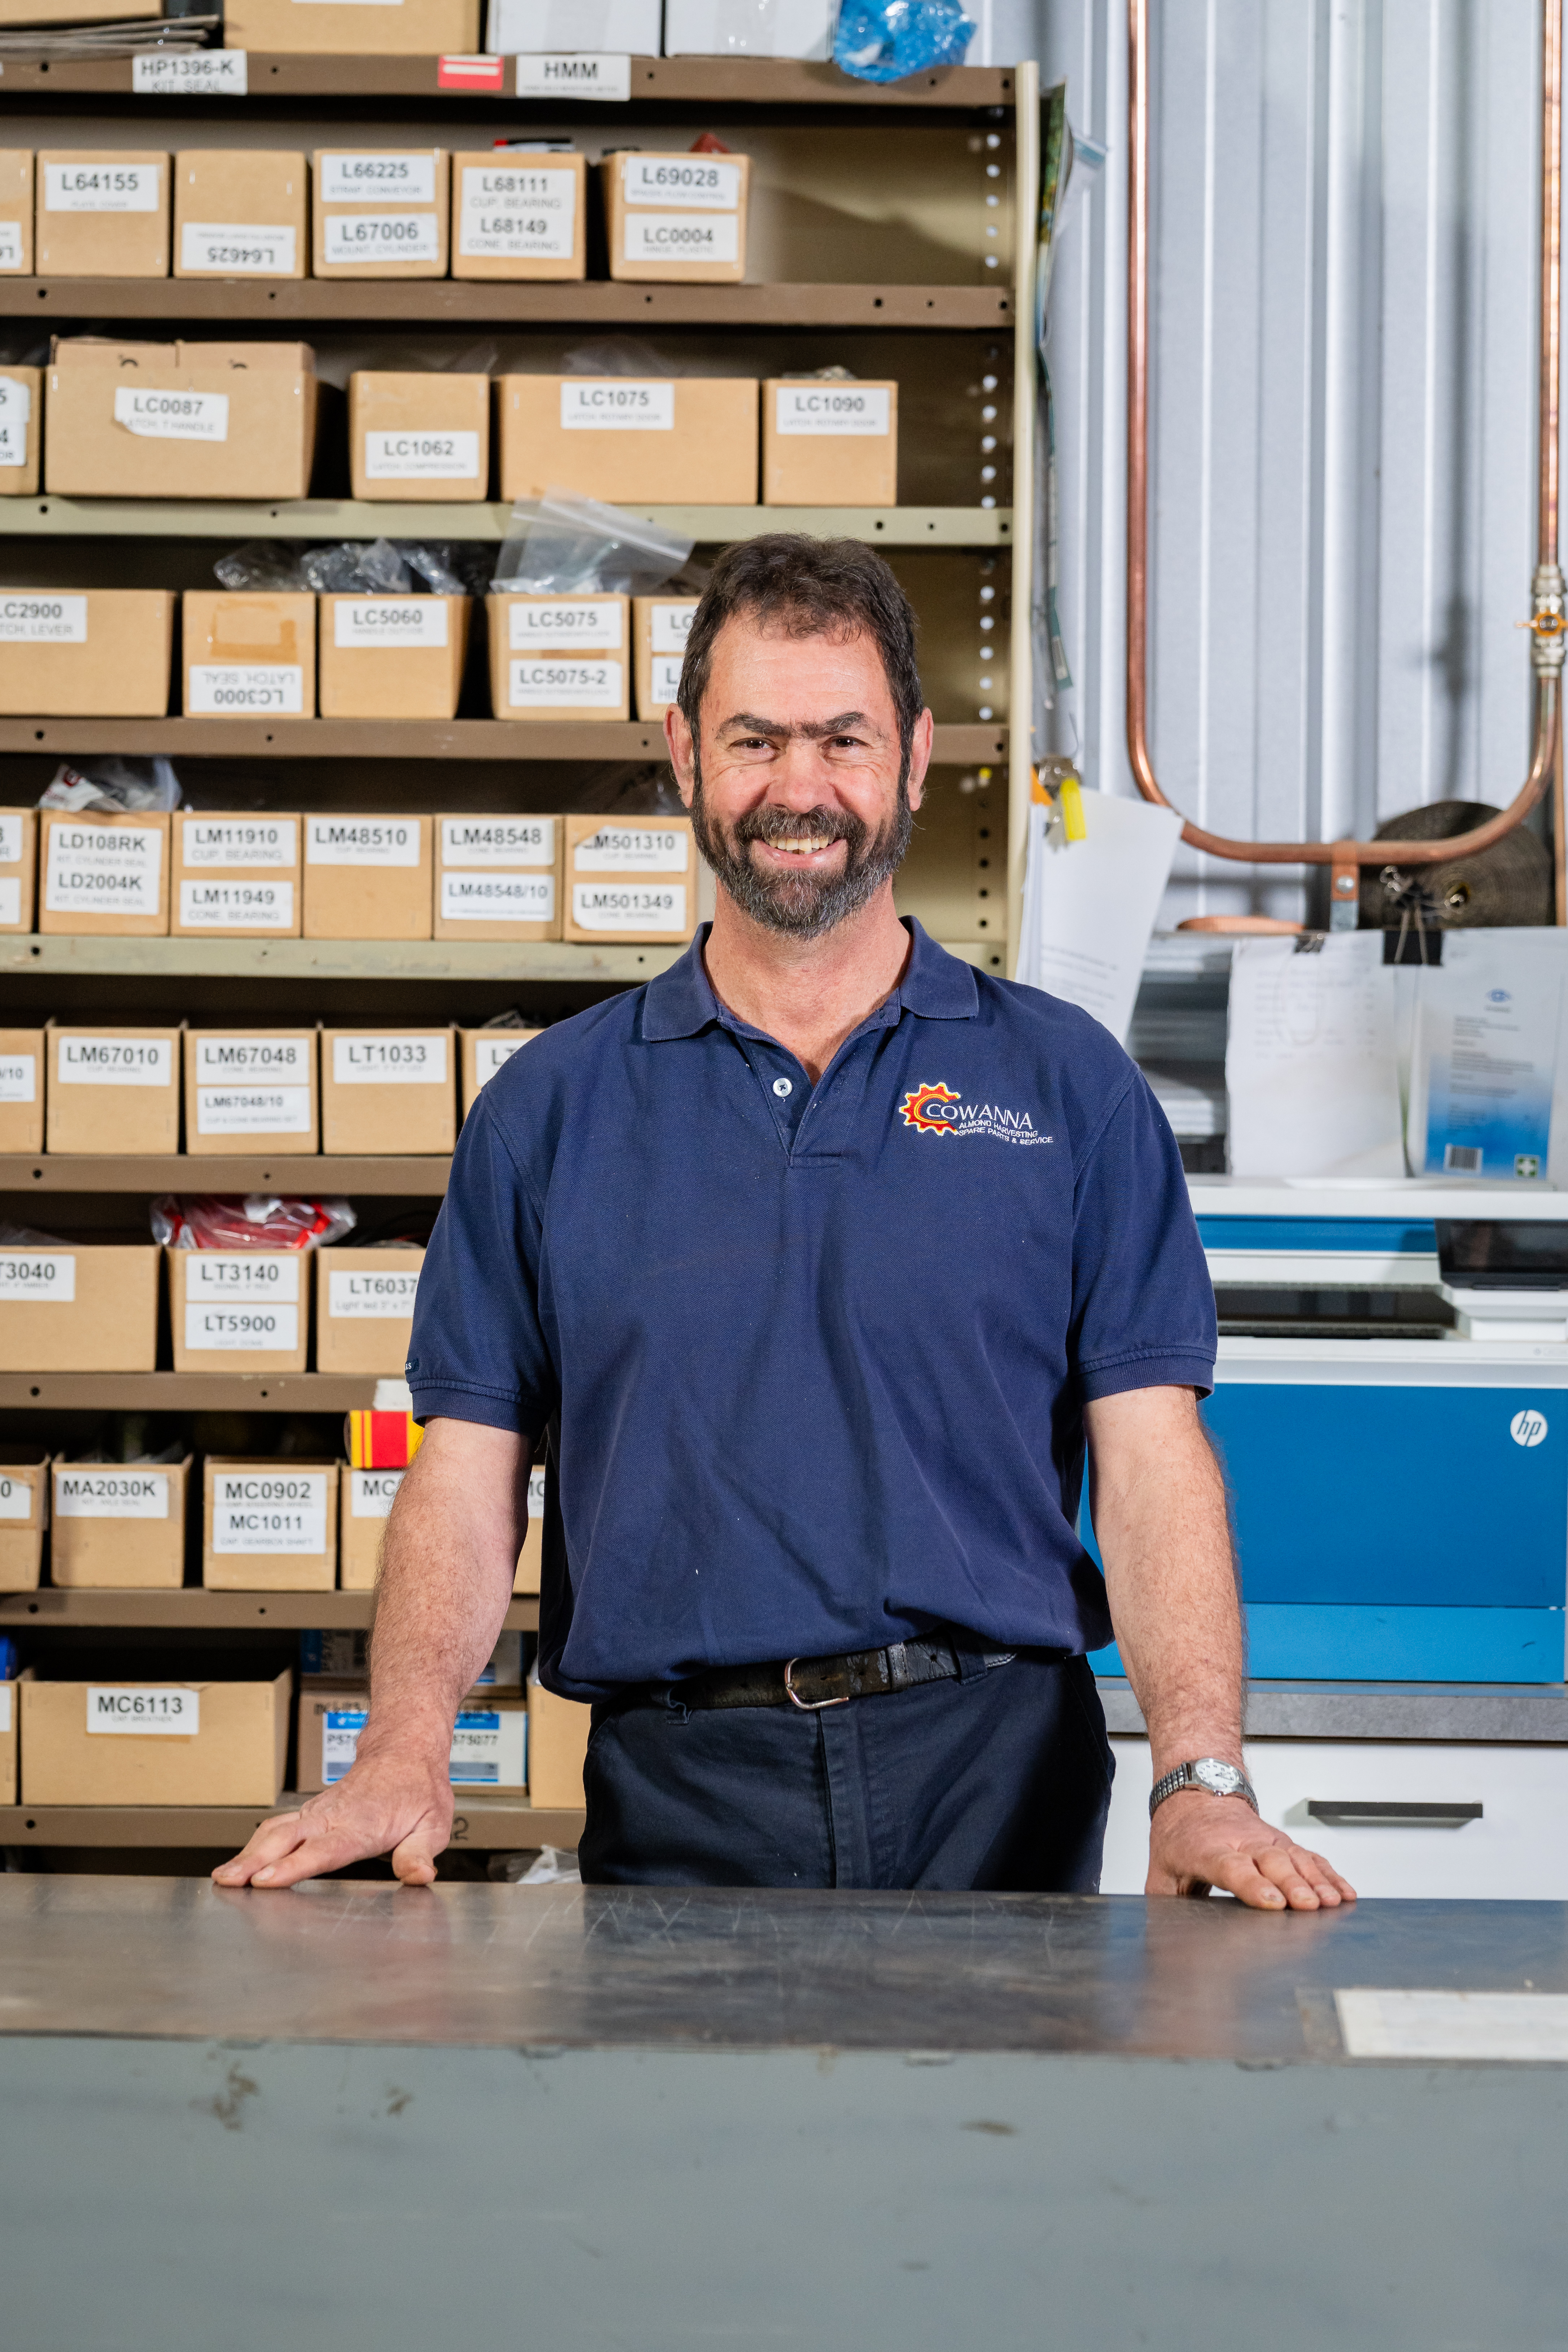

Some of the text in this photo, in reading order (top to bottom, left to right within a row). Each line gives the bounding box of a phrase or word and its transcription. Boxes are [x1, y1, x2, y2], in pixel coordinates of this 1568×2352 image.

[139, 57, 233, 75] HP1396-K
[545, 62, 597, 78] HMM
[342, 163, 409, 178] L66225
[642, 167, 719, 187] L69028
[62, 173, 138, 191] L64155
[483, 176, 547, 192] L68111
[505, 197, 562, 209] BEARING
[342, 222, 418, 241] L67006
[481, 218, 547, 234] L68149
[507, 238, 560, 250] BEARING
[644, 228, 713, 244] LC0004
[208, 247, 274, 263] L64625
[134, 397, 204, 415] LC0087
[580, 390, 649, 406] LC1075
[795, 396, 865, 412] LC1090
[384, 440, 454, 456] LC1062
[0, 602, 62, 619] C2900
[353, 609, 423, 625] LC5060
[528, 611, 597, 627] LC5075
[520, 668, 606, 685] LC5075-2
[214, 689, 284, 705] LC3000
[59, 833, 145, 852] LD108RK
[196, 829, 278, 844] LM11910
[316, 827, 407, 845] LM48510
[451, 828, 541, 845] LM48548
[226, 850, 283, 862] BEARING
[58, 873, 141, 890] LD2004K
[193, 889, 274, 905] LM11949
[449, 883, 549, 899] LM48548/10
[581, 894, 673, 909] LM501349
[227, 910, 280, 922] BEARING
[67, 1046, 158, 1064] LM67010
[205, 1047, 296, 1063] LM67048
[349, 1045, 426, 1063] LT1033
[205, 1096, 283, 1108] LM67048/10
[926, 1104, 1033, 1129] COWANNA
[958, 1127, 986, 1136] SPARE
[988, 1128, 1009, 1142] PARTS
[1020, 1136, 1053, 1145] SERVICE
[959, 1120, 1038, 1138] ALMOND HARVESTING
[202, 1264, 279, 1281] LT3140
[350, 1278, 419, 1297] LT6037
[205, 1315, 275, 1332] LT5900
[1518, 1410, 1542, 1446] hp
[62, 1480, 155, 1496] MA2030K
[226, 1482, 310, 1499] MC0902
[230, 1515, 301, 1530] MC1011
[98, 1696, 182, 1714] MC6113
